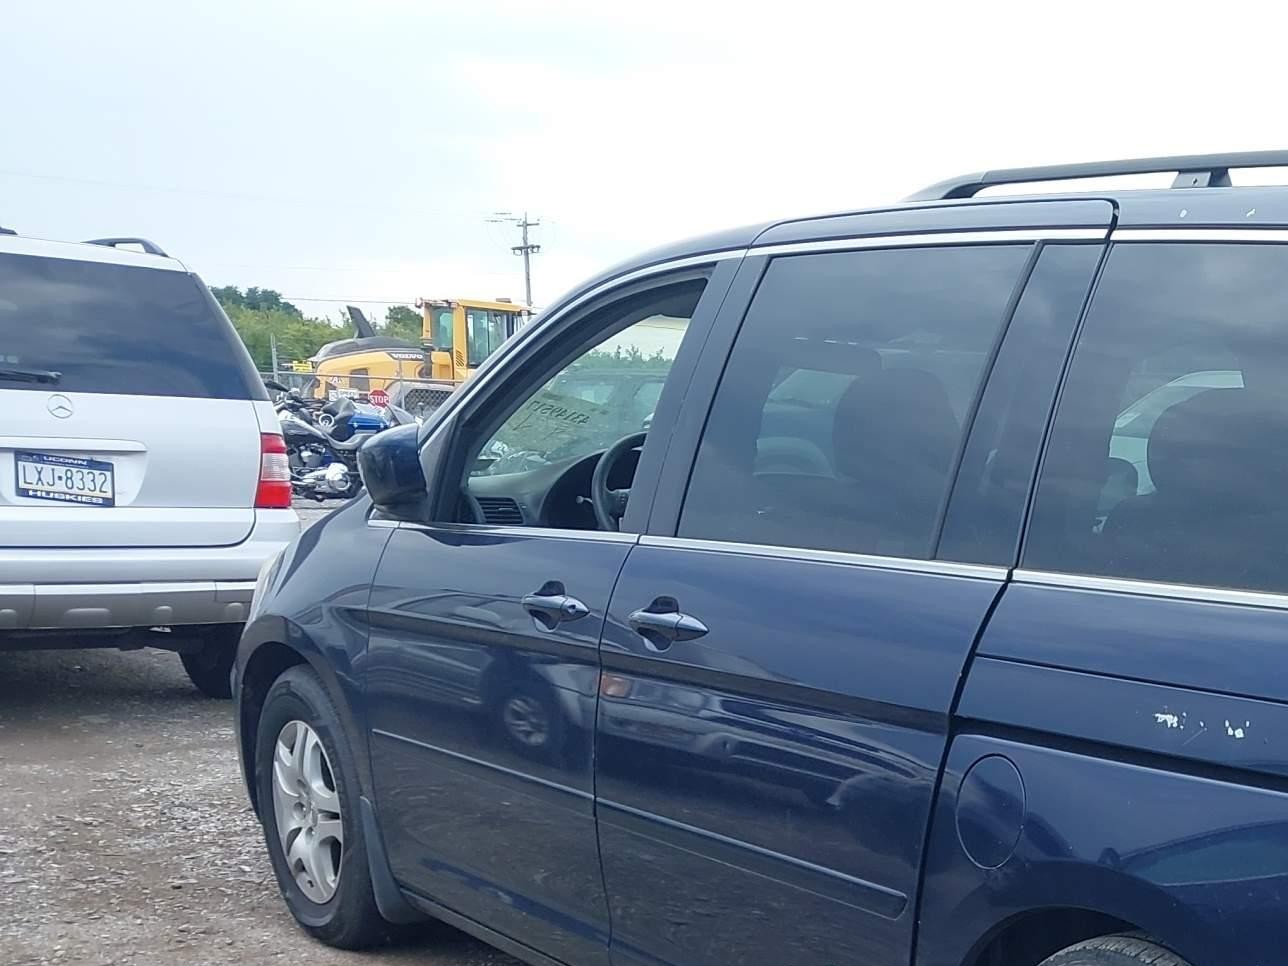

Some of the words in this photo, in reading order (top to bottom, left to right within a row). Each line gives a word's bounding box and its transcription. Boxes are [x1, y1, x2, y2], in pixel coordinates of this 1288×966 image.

[369, 395, 389, 404] STOP
[43, 456, 87, 465] UCONN
[28, 490, 103, 503] HUSKIES
